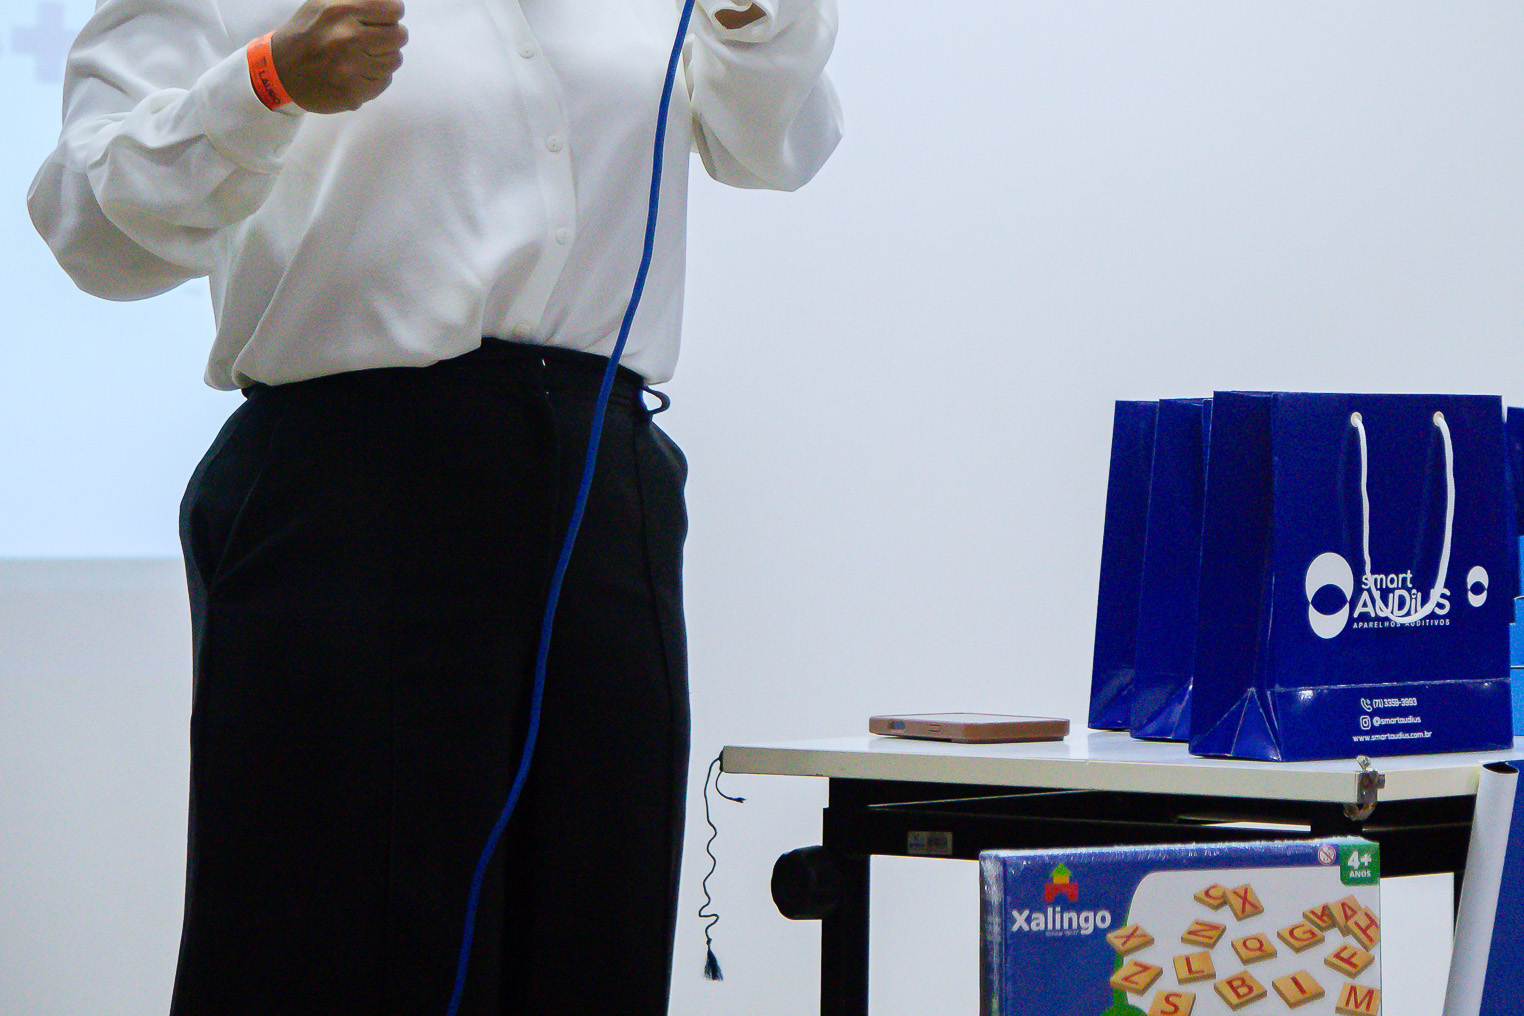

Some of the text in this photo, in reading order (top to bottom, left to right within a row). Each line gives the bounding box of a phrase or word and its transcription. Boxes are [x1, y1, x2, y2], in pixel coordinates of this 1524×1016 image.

[1361, 569, 1413, 589] smart
[1353, 621, 1401, 629] APARELHOS
[1373, 715, 1422, 727] @smartaudius
[1352, 730, 1432, 742] www.smartaudius.com.br
[1347, 850, 1372, 870] 4+
[1349, 869, 1372, 878] ANOS
[1011, 906, 1112, 935] Xalingo
